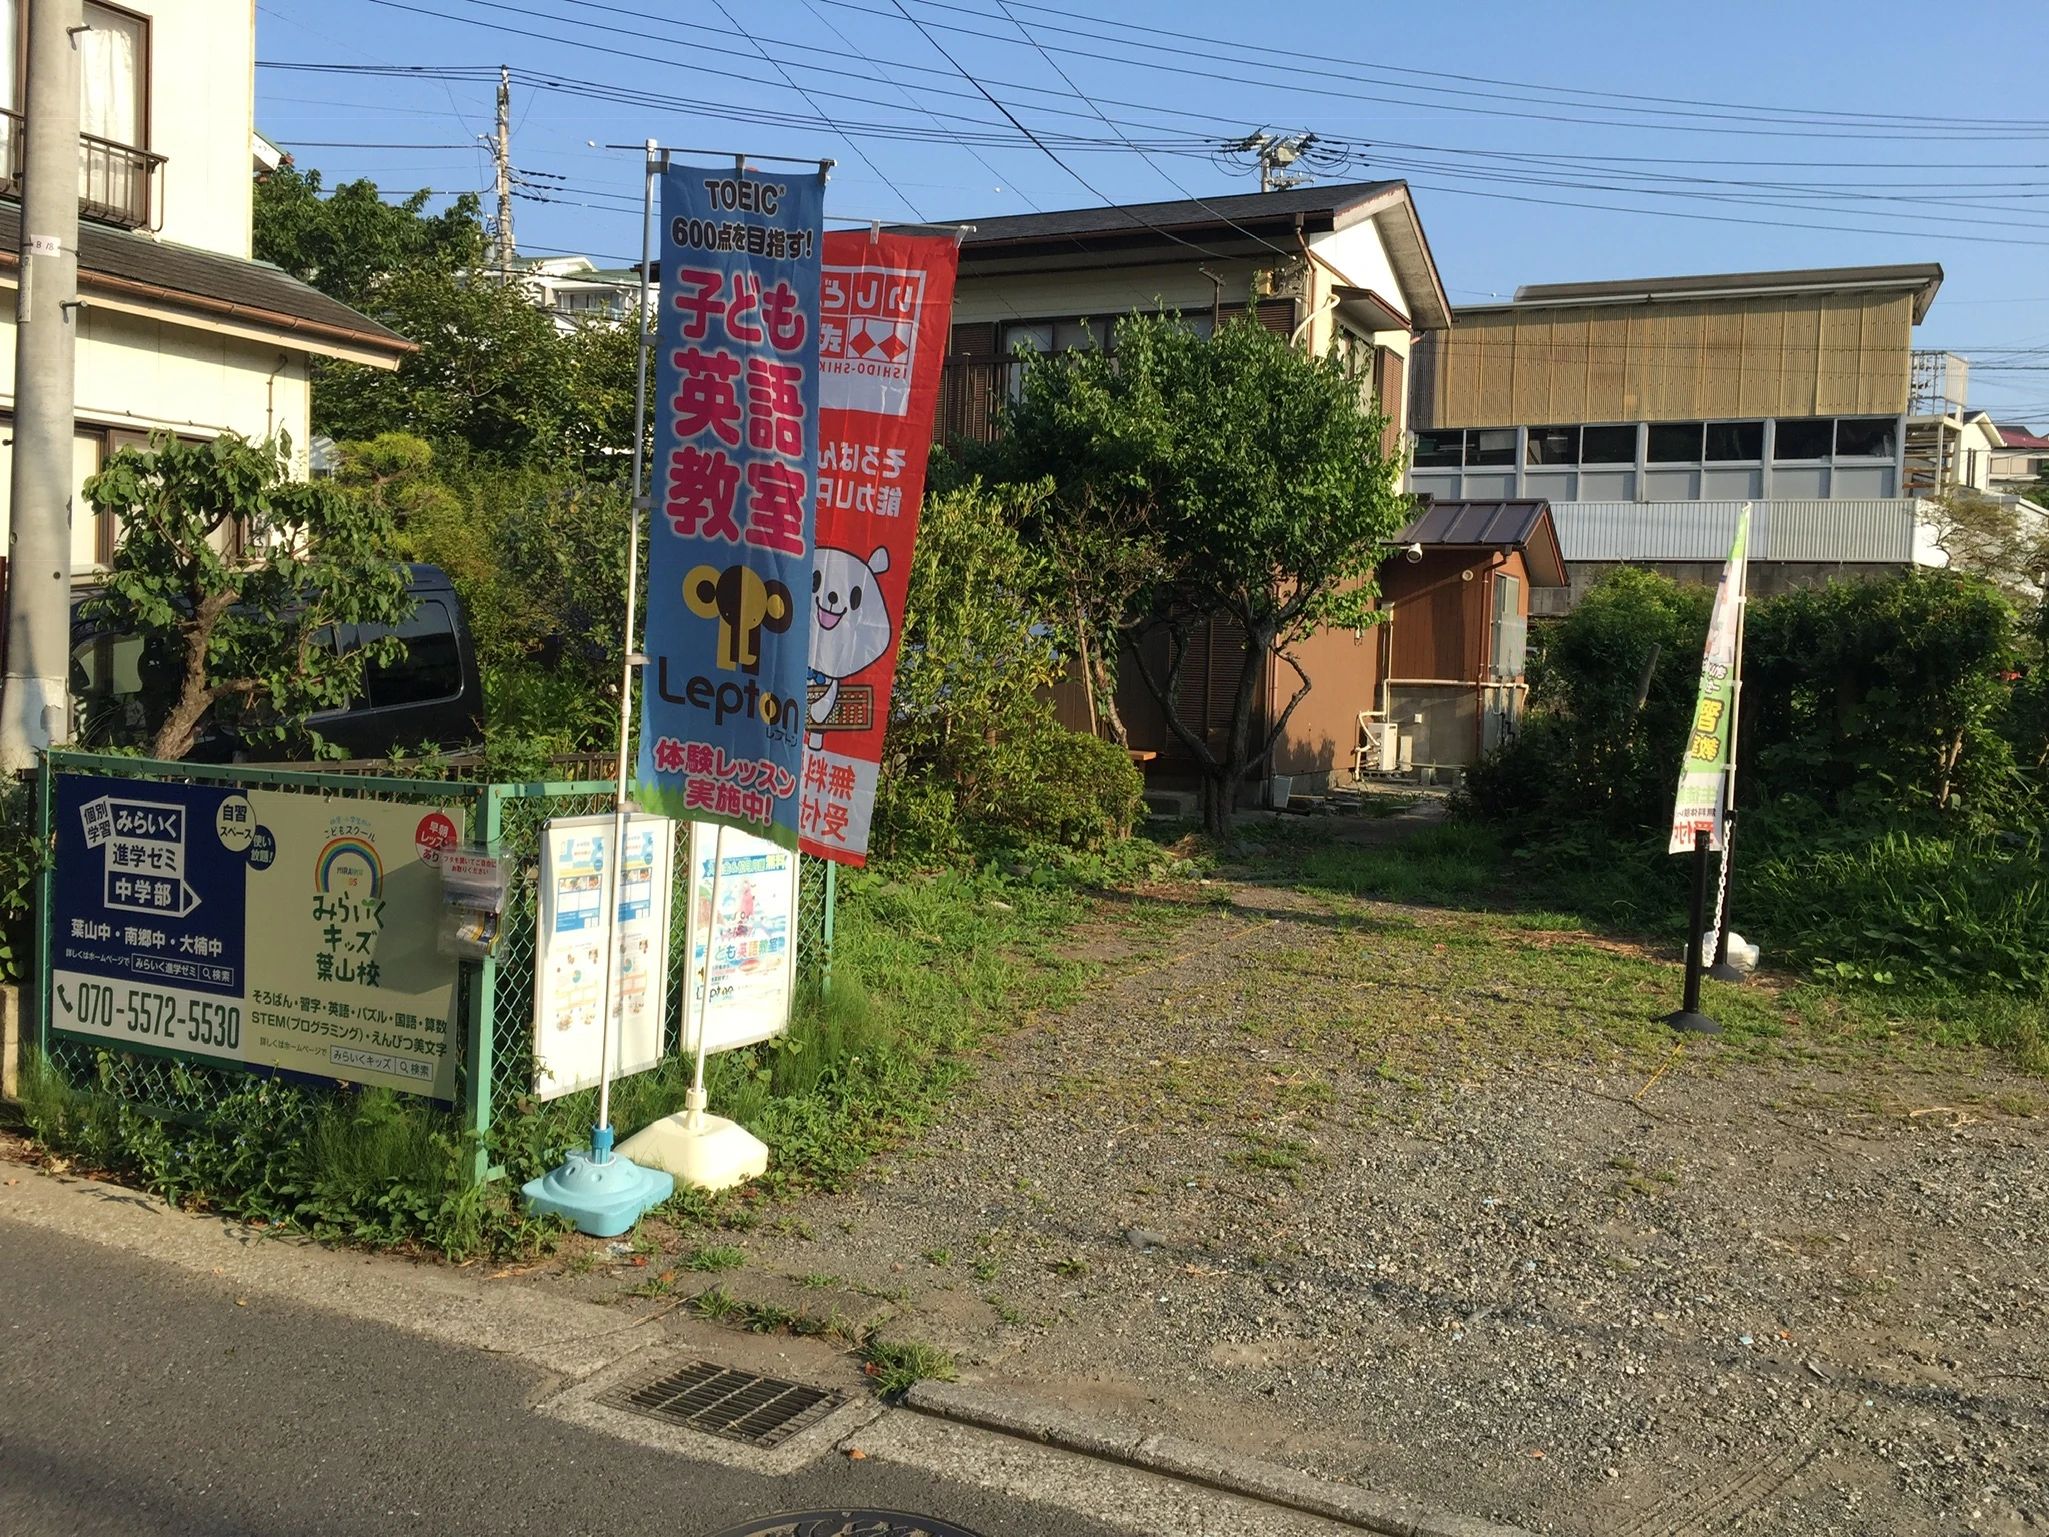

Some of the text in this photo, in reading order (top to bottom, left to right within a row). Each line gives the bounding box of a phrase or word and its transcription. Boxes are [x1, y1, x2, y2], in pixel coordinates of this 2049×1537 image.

[672, 216, 813, 260] 600点を目指す!
[674, 267, 805, 351] 子ども
[672, 346, 805, 457] 英語
[666, 445, 806, 556] 教室
[658, 655, 799, 726] Lepton
[656, 738, 796, 797] 体験レッスン
[84, 801, 108, 825] 個別
[222, 804, 248, 823] 自習
[686, 777, 774, 825] 実施中!
[87, 820, 112, 843] 学習
[116, 810, 177, 839] みらいく
[220, 826, 252, 840] スペース
[324, 825, 377, 843] こどもスクール
[113, 842, 177, 873] 進学ゼミ
[115, 877, 172, 907] 中学部
[312, 891, 386, 929] みらいく
[71, 918, 223, 958] 葉山中・南郷中・大楠中
[323, 923, 377, 955] キッズ
[135, 957, 197, 977] みらいく進学ゼミ
[212, 968, 231, 982] 検索
[316, 952, 382, 988] 葉山校
[77, 982, 240, 1049] 070-5572-5530
[333, 1050, 393, 1071] みらいくキッズ
[410, 1062, 430, 1078] 検索
